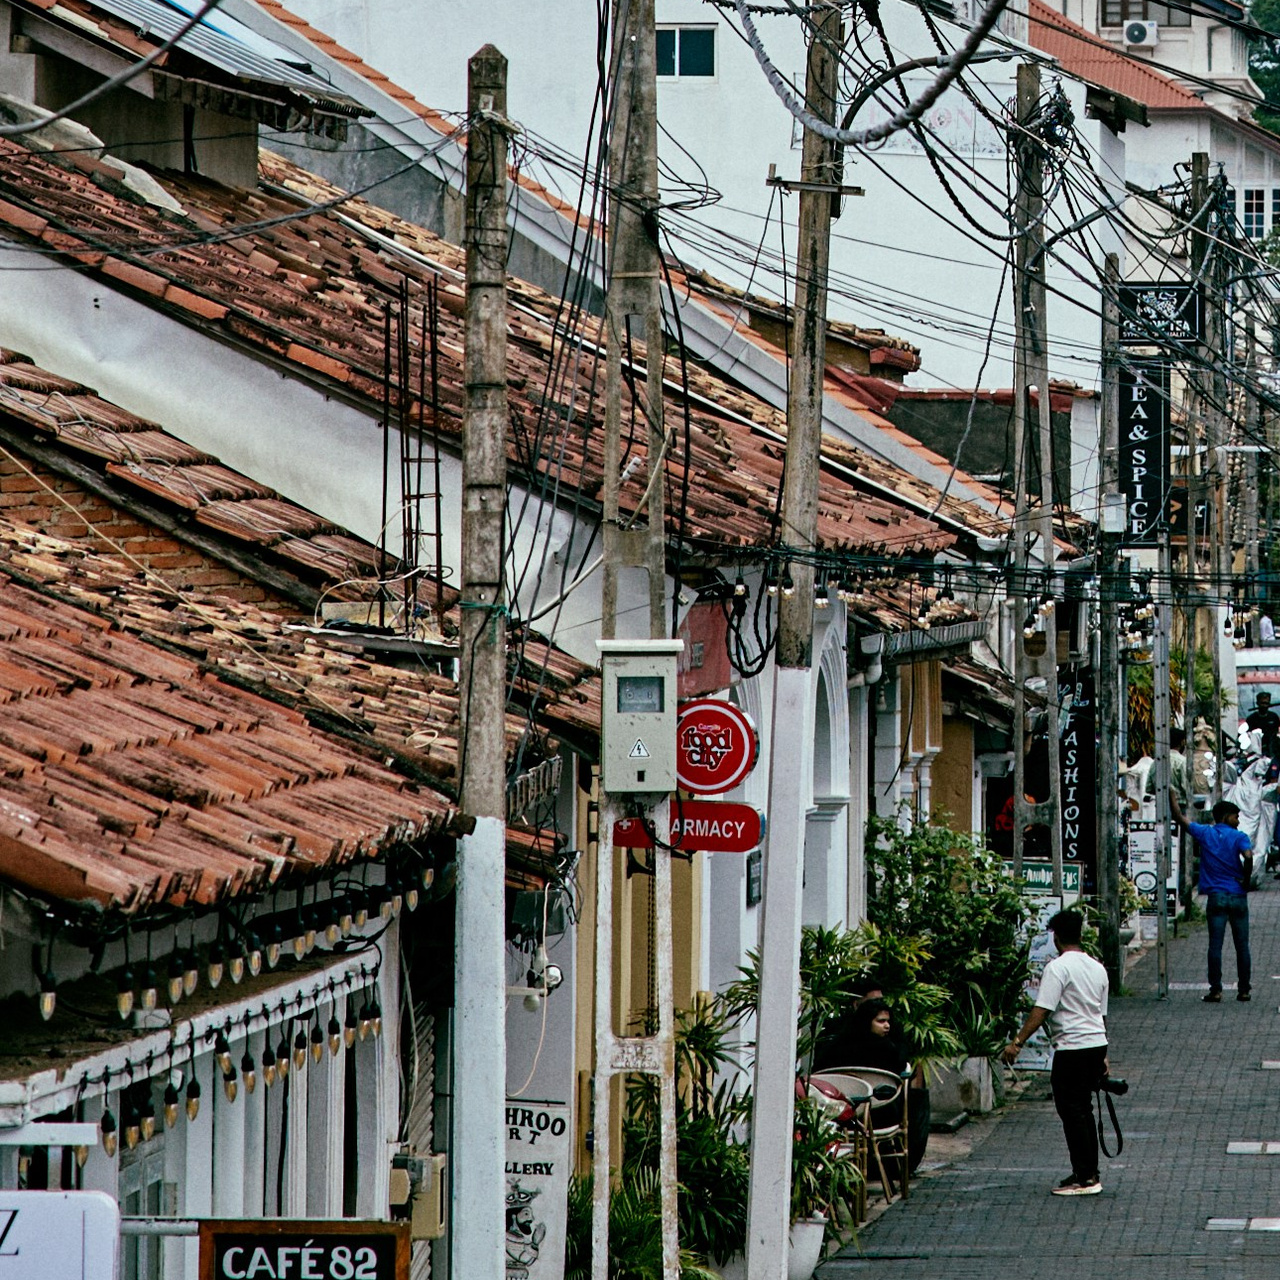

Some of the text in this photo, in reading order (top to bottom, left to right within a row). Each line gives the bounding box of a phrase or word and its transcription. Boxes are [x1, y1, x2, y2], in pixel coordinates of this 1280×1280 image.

[1128, 424, 1149, 441] &
[1130, 448, 1149, 535] SPICE
[681, 725, 733, 750] food
[1063, 712, 1080, 859] FASHIONS
[670, 819, 745, 839] ARMACY
[506, 1107, 567, 1137] HROO
[505, 1162, 555, 1176] LLERY
[222, 1239, 378, 1280] CAFÉ 82
